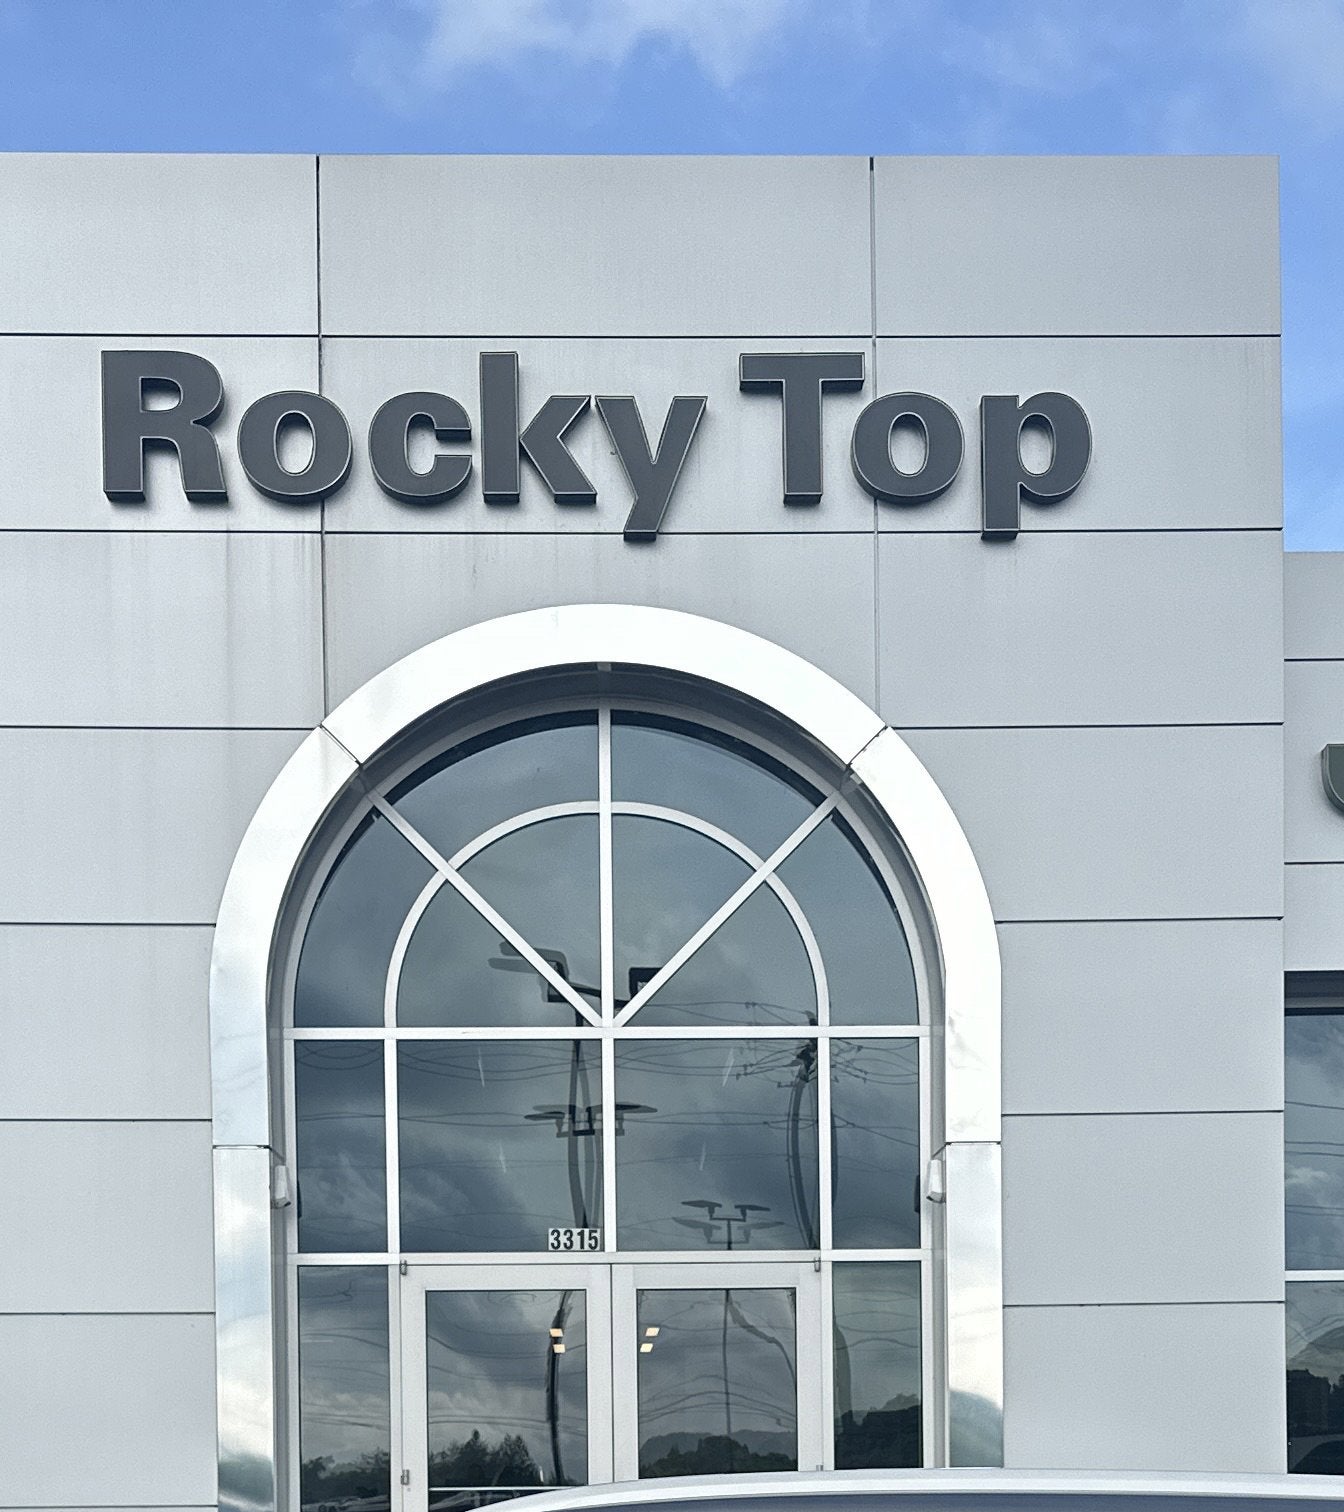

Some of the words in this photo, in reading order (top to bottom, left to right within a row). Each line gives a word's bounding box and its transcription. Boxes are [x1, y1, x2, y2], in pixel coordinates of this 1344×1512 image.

[100, 349, 707, 541] Rocky
[738, 351, 1093, 540] Top
[550, 1228, 599, 1250] 3315
